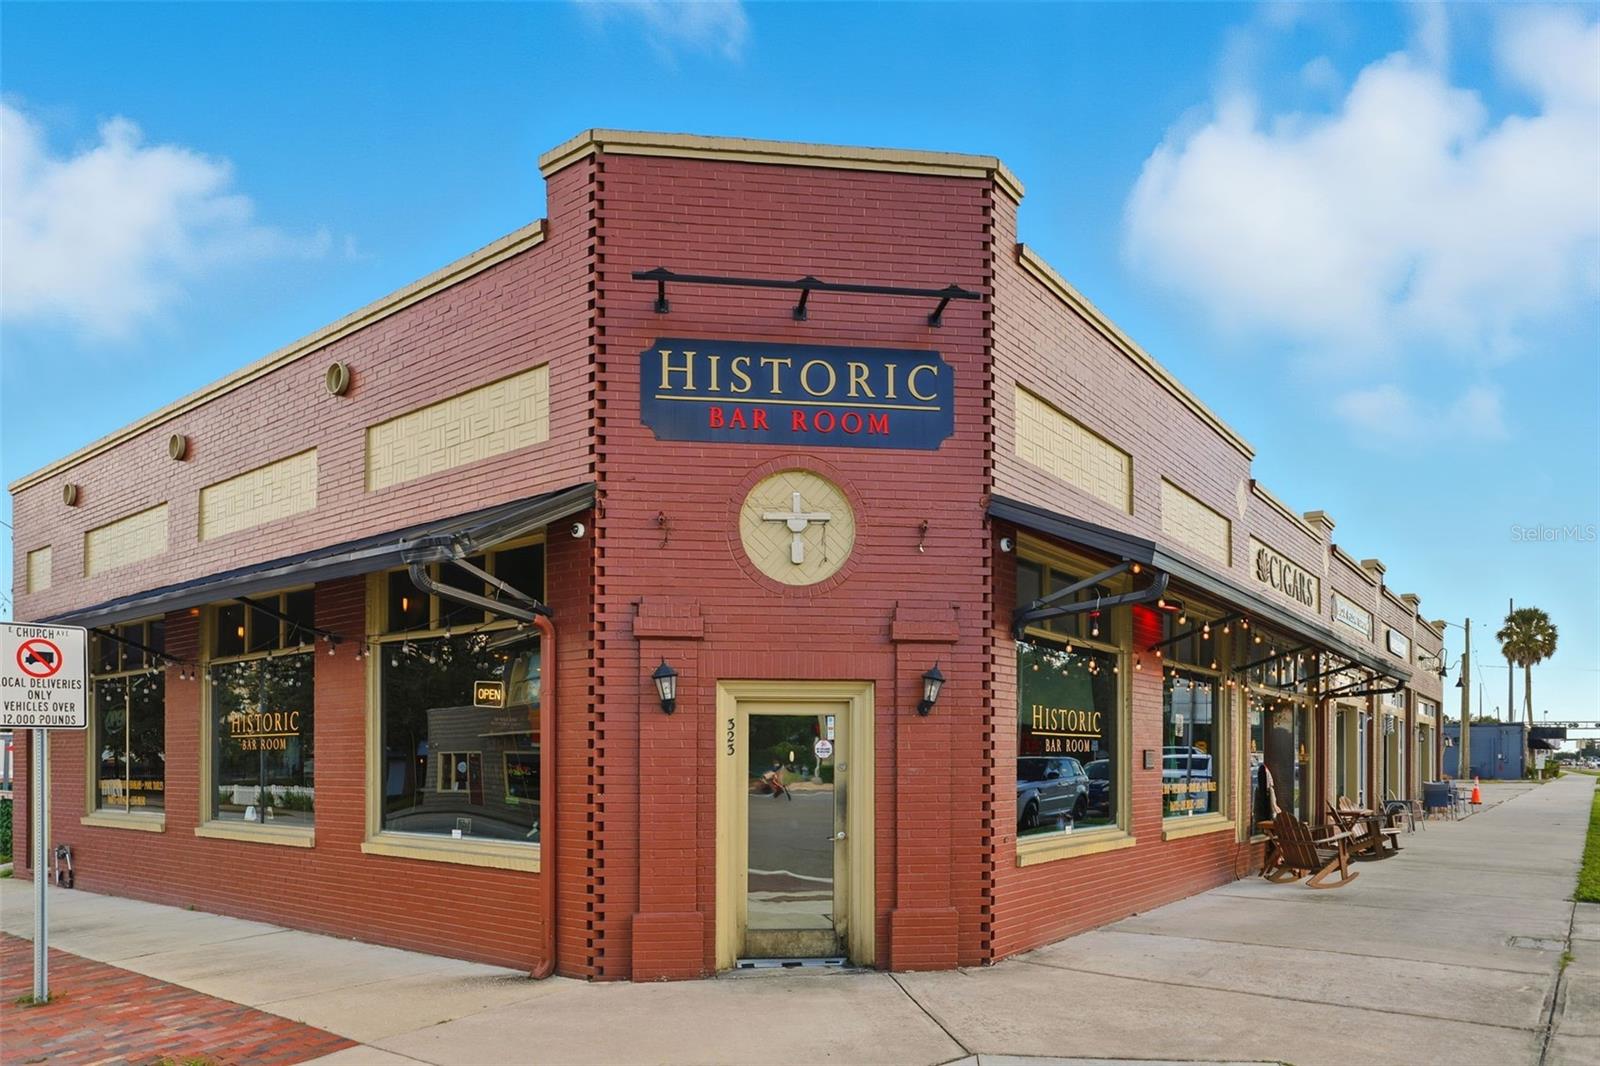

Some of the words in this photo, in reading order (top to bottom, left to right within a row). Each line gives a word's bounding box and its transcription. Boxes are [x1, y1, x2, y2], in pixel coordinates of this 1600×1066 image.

[658, 350, 938, 401] HISTORIC
[709, 406, 768, 430] BAR
[792, 410, 890, 435] ROOM
[1270, 555, 1314, 607] CIGARS
[16, 627, 54, 639] CHURCH
[0, 677, 26, 687] OCAL
[30, 678, 82, 689] DELIVERIES
[28, 690, 52, 700] ONLY
[478, 688, 501, 700] OPEN
[4, 701, 49, 712] VEHICLES
[52, 702, 75, 712] OVER
[40, 715, 76, 725] POUNDS
[231, 711, 299, 733] HISTORIC
[1032, 704, 1101, 733] HISTORIC
[727, 717, 736, 757] 323
[242, 739, 257, 750] BAR
[260, 738, 287, 750] ROOM
[1045, 739, 1062, 752] BAR
[1065, 739, 1090, 752] ROOM
